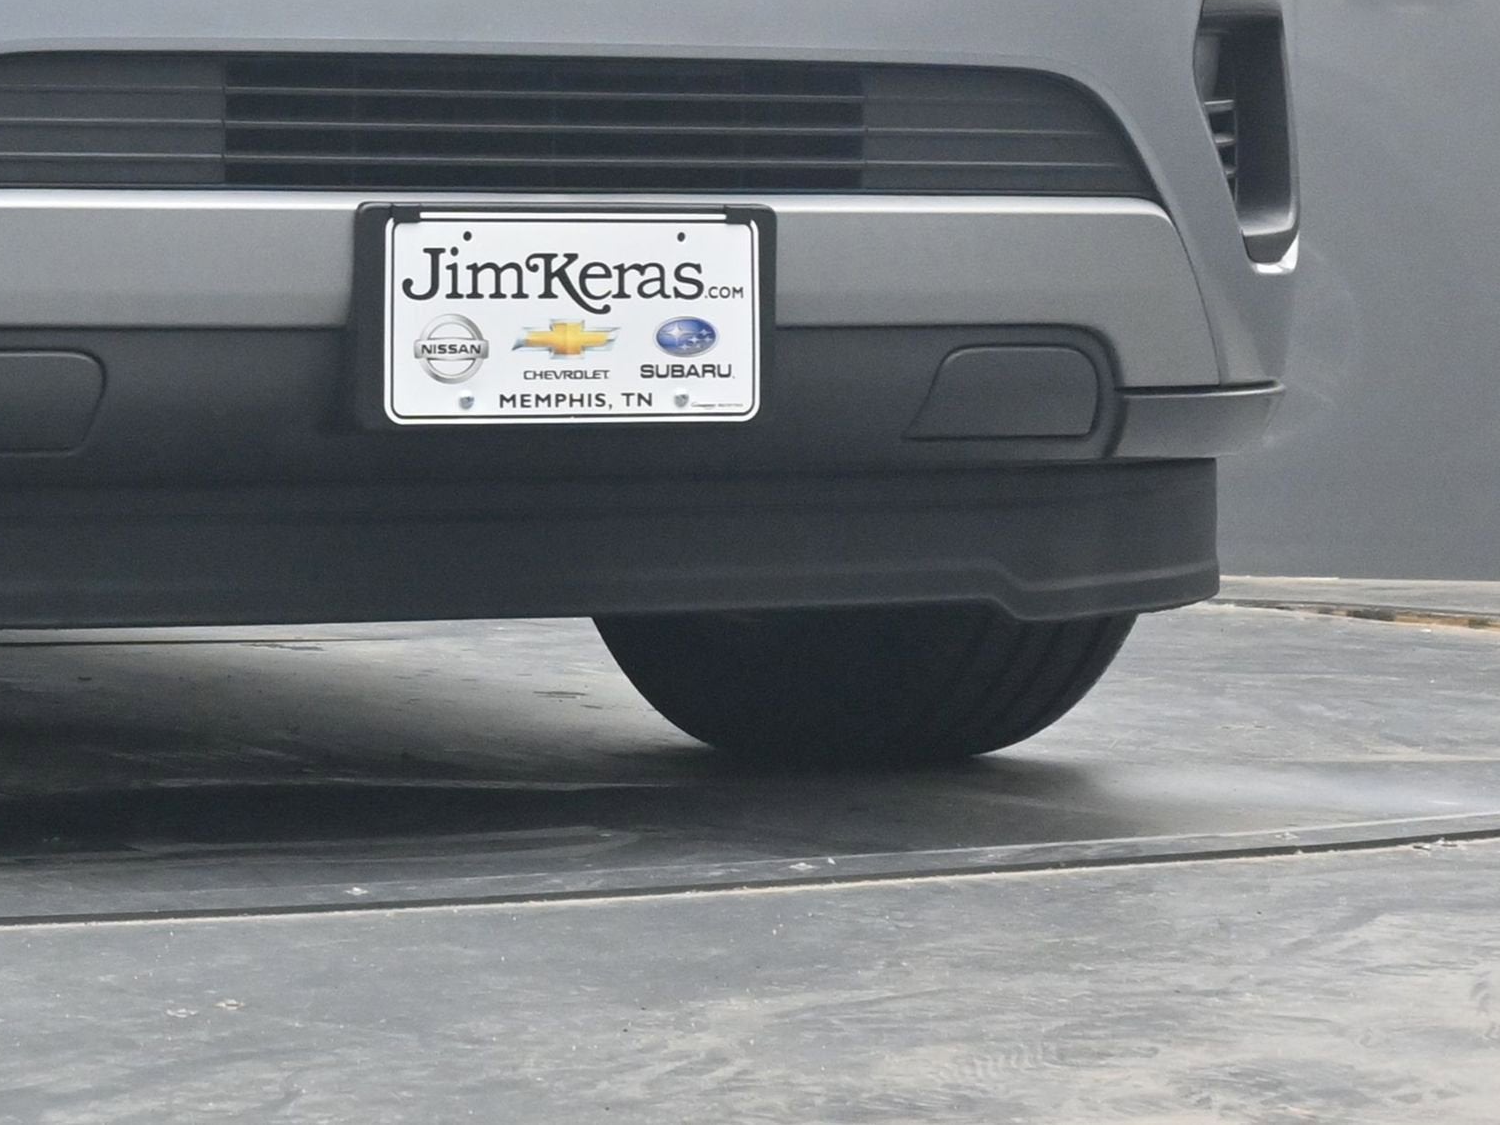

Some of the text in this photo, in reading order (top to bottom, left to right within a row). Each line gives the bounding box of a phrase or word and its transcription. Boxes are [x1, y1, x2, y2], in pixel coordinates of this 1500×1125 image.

[420, 343, 482, 355] NISSAN
[523, 369, 611, 381] CHEVROLET
[640, 364, 732, 379] SUBARU
[499, 392, 653, 410] MEMPHIS, TN
